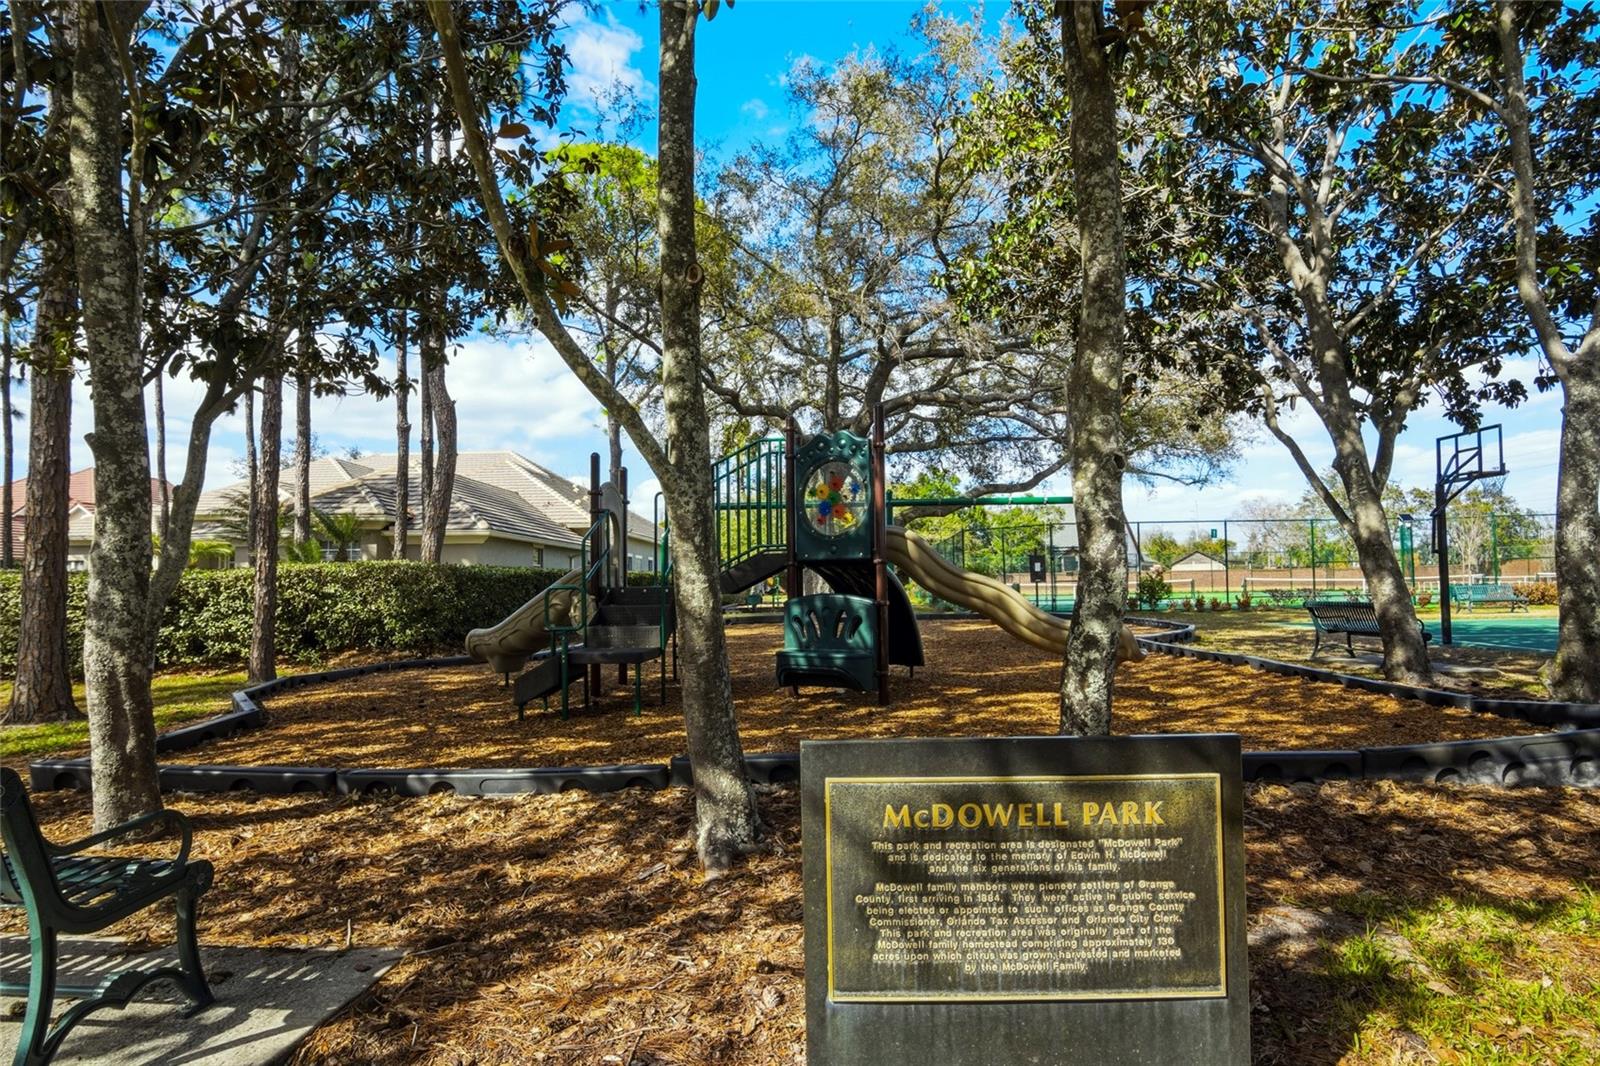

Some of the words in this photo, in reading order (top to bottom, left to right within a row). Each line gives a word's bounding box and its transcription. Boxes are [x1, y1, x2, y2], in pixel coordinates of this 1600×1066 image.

[883, 803, 1069, 829] McDOWELL
[1083, 801, 1165, 826] PARK
[872, 841, 893, 850] This
[897, 841, 919, 852] park
[923, 841, 942, 850] and
[945, 841, 996, 850] recreation
[1000, 841, 1023, 849] area
[1026, 840, 1035, 848] is
[1038, 839, 1095, 850] designated
[888, 853, 906, 862] and
[910, 853, 919, 862] is
[922, 852, 972, 861] dedicated
[976, 852, 986, 861] to
[990, 852, 1008, 861] the
[1011, 852, 1051, 862] memory
[1056, 851, 1067, 860] of
[1070, 851, 1100, 860] Edwin
[1105, 850, 1115, 860] H.
[1119, 850, 1167, 859] McDowell
[929, 864, 947, 873] and
[952, 864, 969, 873] the
[972, 864, 987, 873] six
[991, 863, 1051, 874] generations
[1054, 863, 1064, 872] of
[1068, 862, 1083, 871] his
[1088, 862, 1121, 873] family.
[875, 883, 923, 892] McDowell
[927, 882, 956, 893] family
[960, 882, 1007, 891] members
[1010, 882, 1035, 891] were
[1039, 881, 1077, 892] pioneer
[1081, 880, 1120, 890] settlers
[1123, 880, 1134, 889] of
[1138, 880, 1175, 890] Orange
[898, 894, 918, 903] first
[922, 894, 960, 905] arriving
[963, 894, 973, 903] in
[1013, 893, 1036, 903] They
[1042, 893, 1067, 902] were
[1073, 892, 1102, 901] active
[1106, 891, 1116, 900] in
[1122, 891, 1153, 902] public
[1158, 890, 1196, 900] service
[866, 906, 894, 917] being
[899, 906, 935, 915] elected
[938, 907, 950, 915] or
[953, 906, 1004, 916] appointed
[1007, 905, 1018, 914] to
[1024, 904, 1048, 913] such
[1054, 904, 1089, 913] offices
[1093, 904, 1104, 913] as
[1108, 903, 1145, 914] Orange
[1148, 902, 1185, 913] County
[946, 916, 986, 926] Orlando
[990, 916, 1009, 925] Tax
[1013, 915, 1058, 925] Assessor
[1061, 915, 1080, 924] and
[1086, 915, 1125, 924] Orlando
[1129, 914, 1149, 925] City
[1153, 913, 1182, 923] Clerk.
[879, 929, 901, 938] This
[907, 929, 930, 939] park
[934, 928, 952, 937] and
[956, 928, 1007, 937] recreation
[1010, 928, 1033, 937] area
[1037, 928, 1056, 937] was
[1060, 927, 1107, 938] originally
[1113, 927, 1134, 937] part
[1139, 926, 1150, 935] of
[1154, 926, 1172, 935] the
[877, 940, 925, 949] McDowell
[928, 940, 958, 950] family
[962, 939, 1018, 949] homestead
[1021, 939, 1078, 950] comprising
[1082, 938, 1153, 949] approximately
[872, 953, 900, 961] acres
[904, 953, 929, 963] upon
[932, 952, 962, 961] which
[966, 951, 996, 960] citrus
[1000, 952, 1018, 961] was
[1059, 949, 1108, 959] harvested
[1112, 949, 1130, 958] and
[1134, 948, 1181, 958] marketed
[965, 963, 976, 973] by
[980, 962, 998, 971] the
[1002, 962, 1049, 971] McDowell
[1053, 961, 1088, 972] Family.
